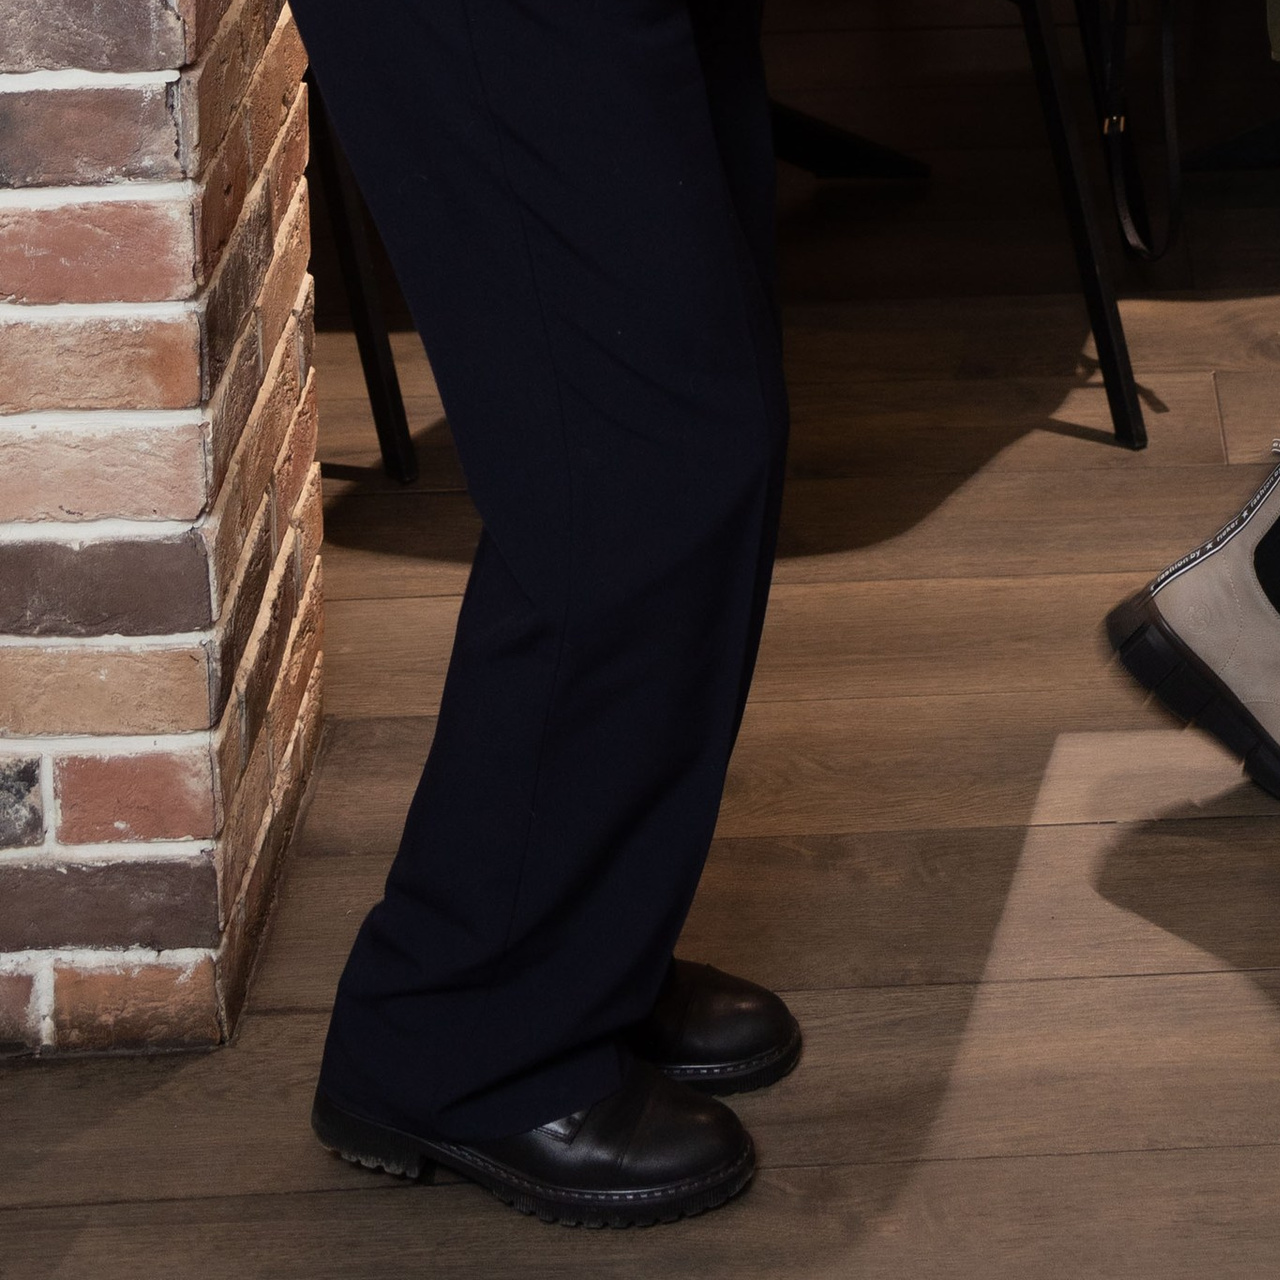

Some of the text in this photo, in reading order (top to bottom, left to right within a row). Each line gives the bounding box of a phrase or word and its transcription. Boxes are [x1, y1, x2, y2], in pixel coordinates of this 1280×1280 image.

[1157, 556, 1189, 583] fashion
[1189, 549, 1201, 560] by
[1250, 476, 1274, 507] fashion
